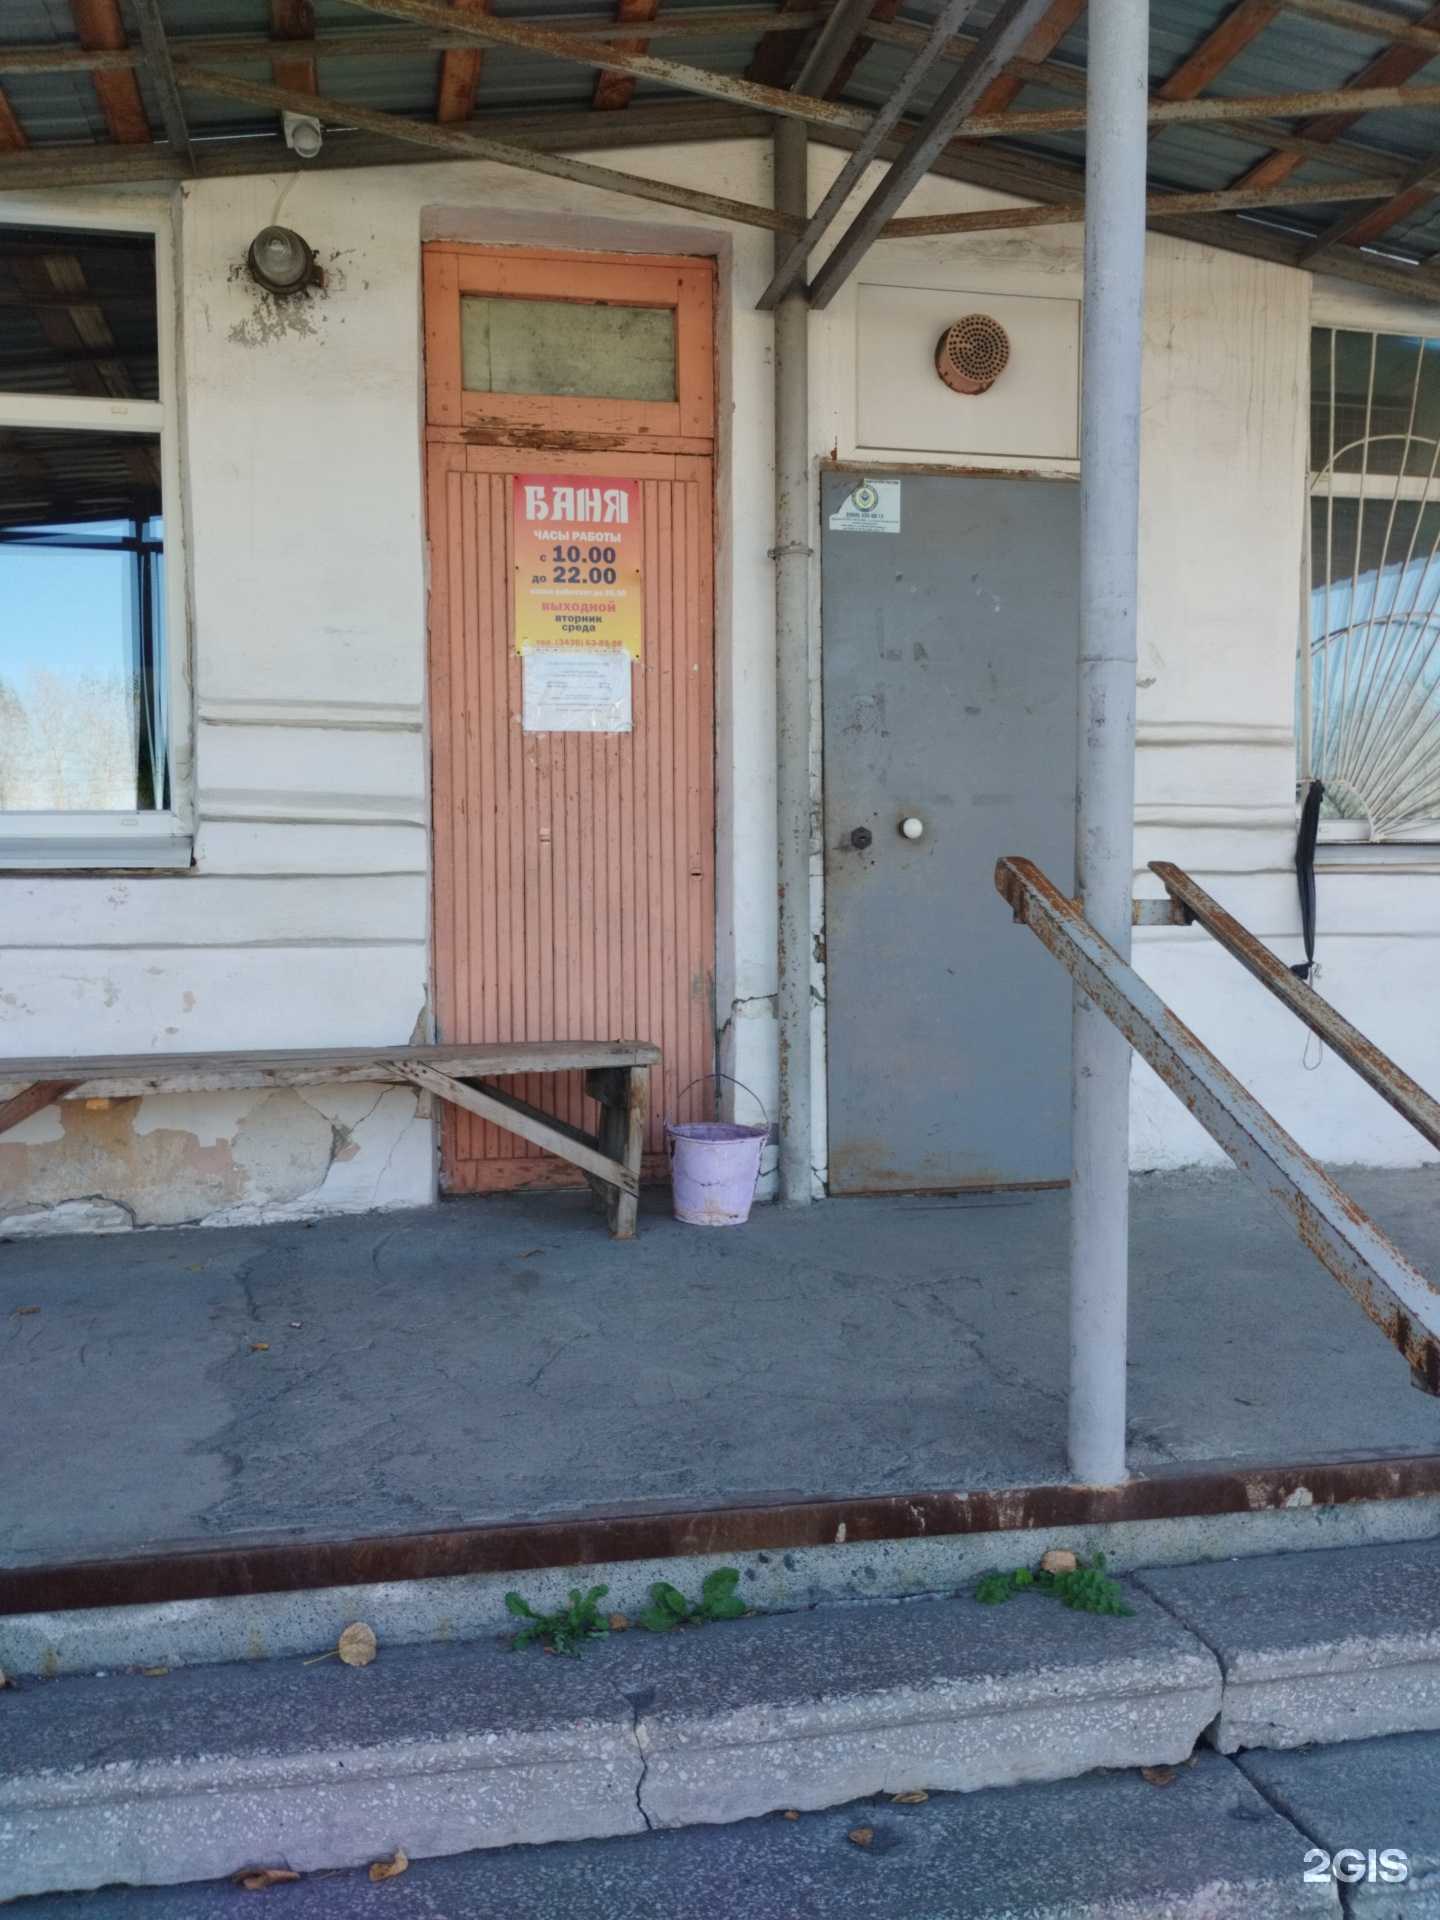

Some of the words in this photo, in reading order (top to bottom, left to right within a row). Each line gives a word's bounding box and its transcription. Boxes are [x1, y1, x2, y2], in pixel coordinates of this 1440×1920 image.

[524, 485, 629, 524] БАНЯ
[534, 530, 570, 541] ЧАСЫ
[572, 530, 622, 543] РАБОТЫ
[552, 545, 617, 564] 10.00
[531, 574, 547, 584] до
[553, 566, 617, 584] 22.00
[555, 615, 602, 625] вторник
[562, 624, 597, 633] среда
